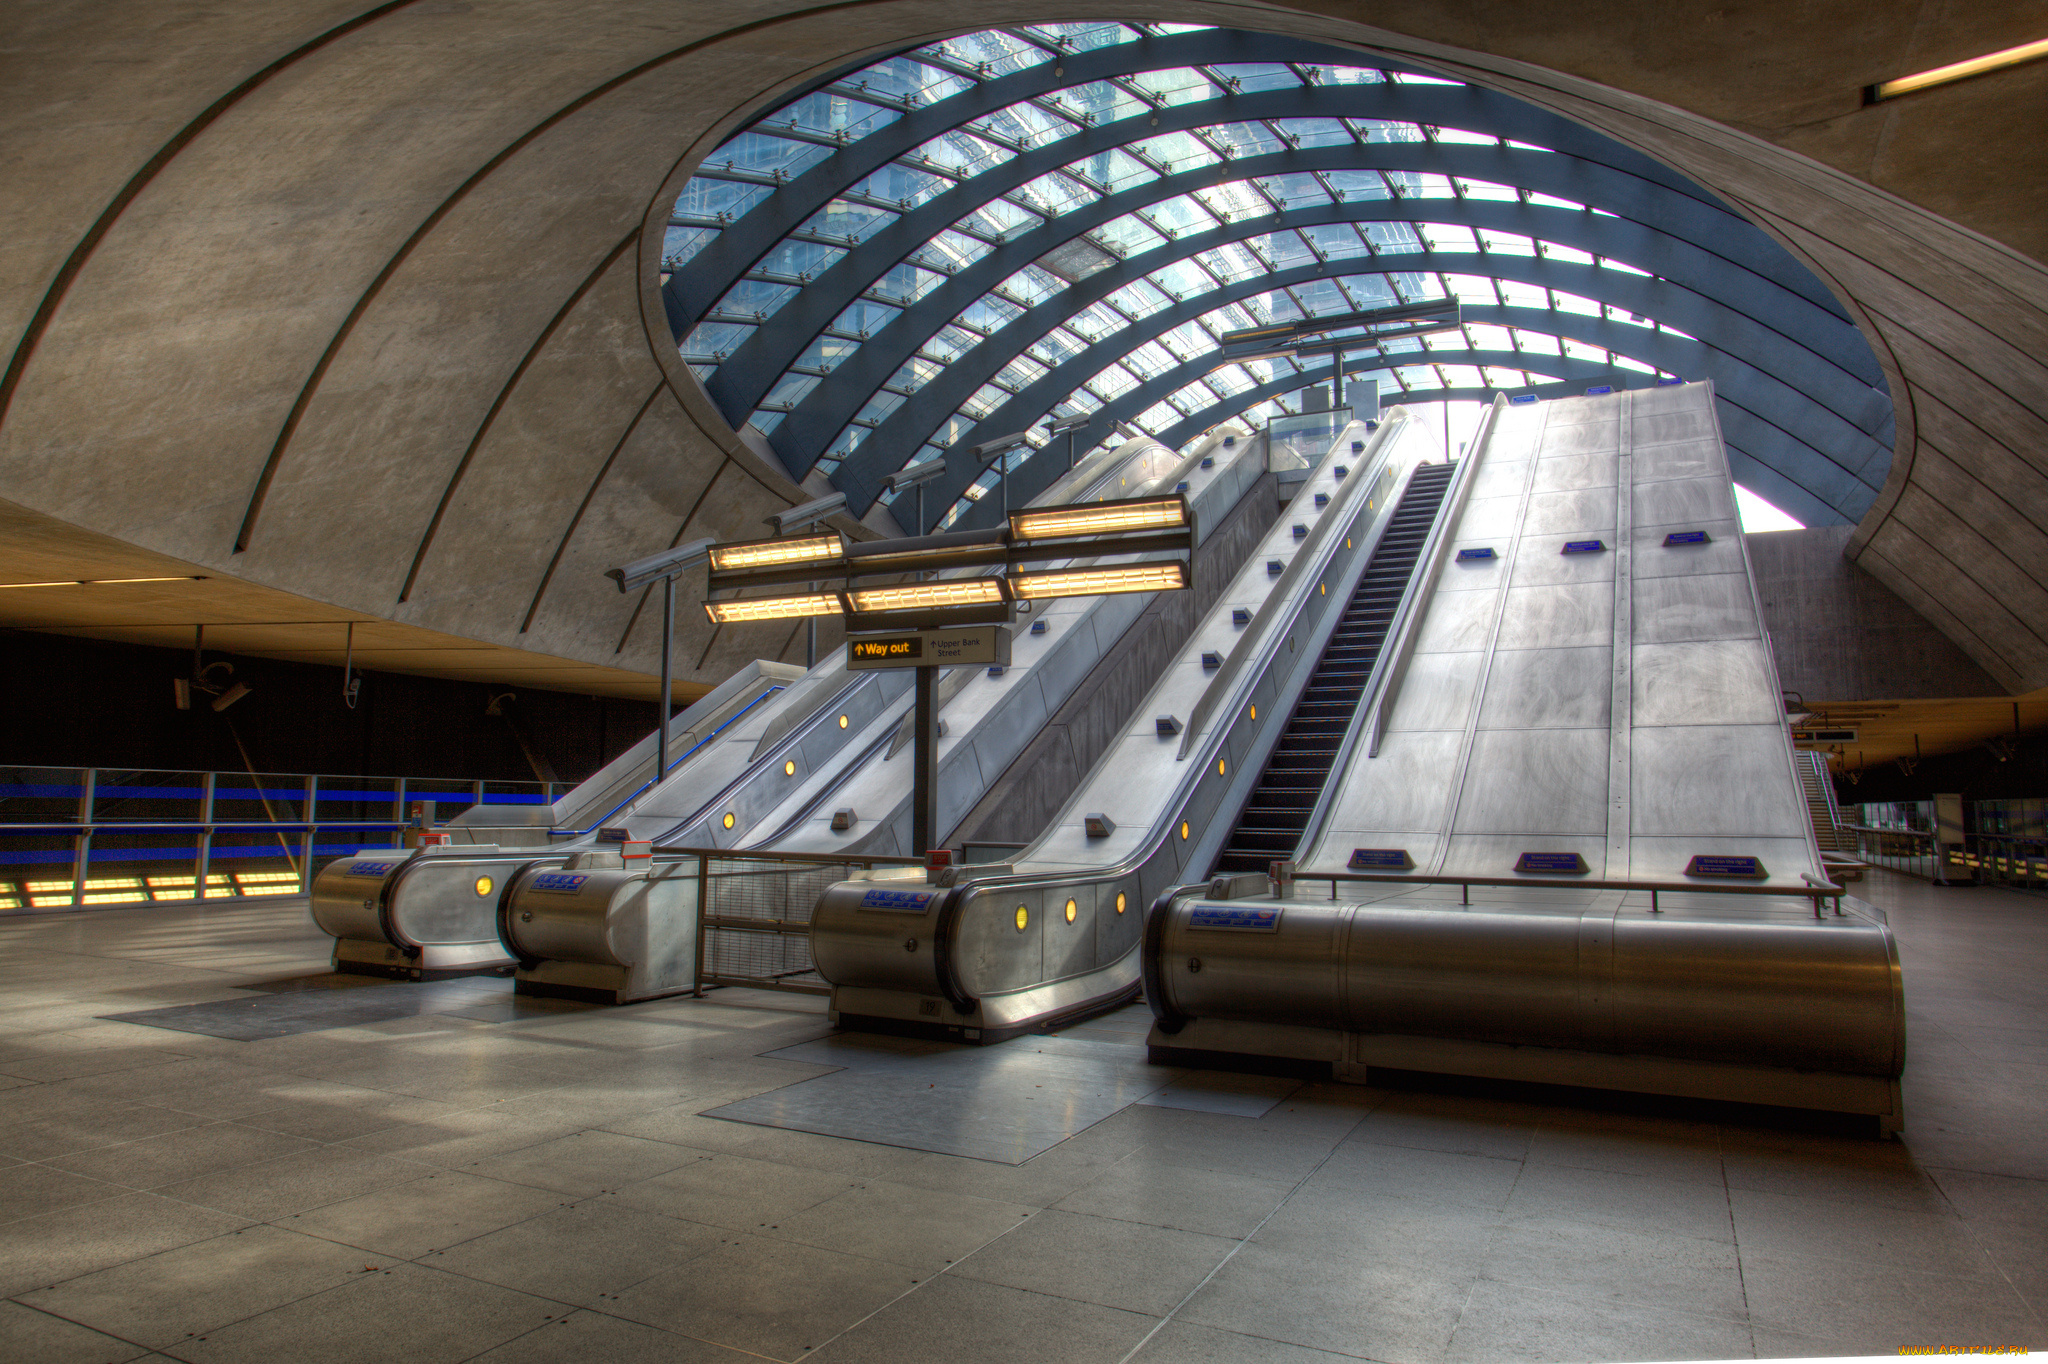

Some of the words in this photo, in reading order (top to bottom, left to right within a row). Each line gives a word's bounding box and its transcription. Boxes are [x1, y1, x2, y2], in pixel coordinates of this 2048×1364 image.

[865, 643, 888, 656] Way
[890, 642, 910, 653] out
[937, 640, 960, 649] Upper
[962, 638, 981, 646] Bank
[937, 649, 961, 657] Street
